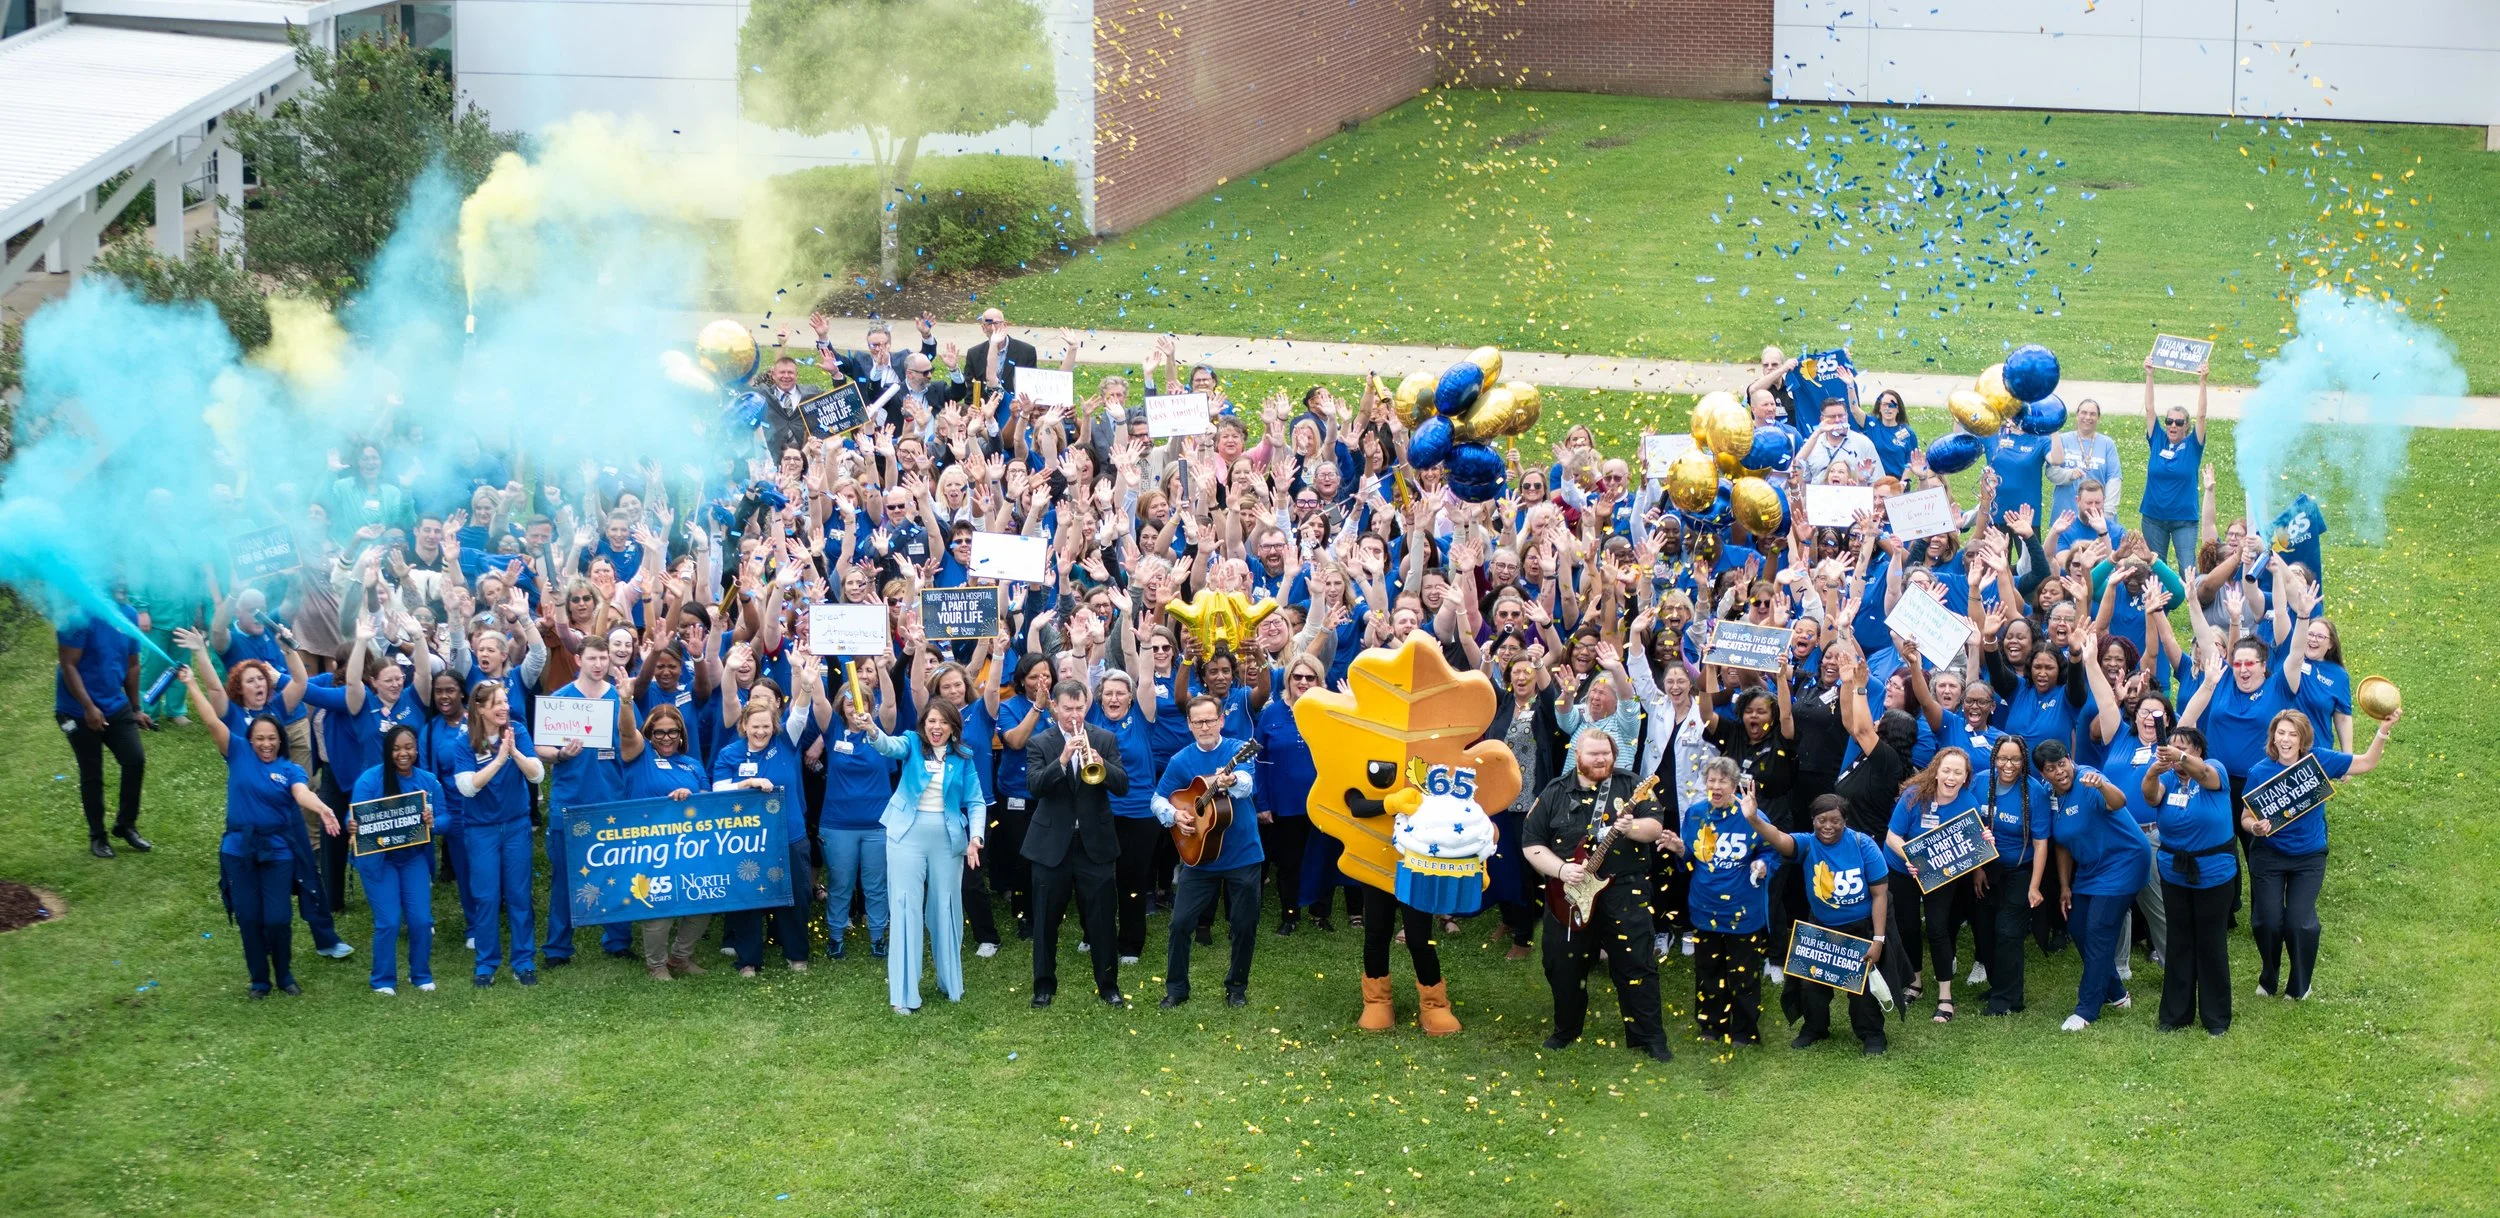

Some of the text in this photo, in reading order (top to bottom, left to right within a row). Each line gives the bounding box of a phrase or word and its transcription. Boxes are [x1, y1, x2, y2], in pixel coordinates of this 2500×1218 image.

[2156, 348, 2170, 357] FOR
[2161, 340, 2206, 355] THANK YOU
[1817, 354, 1838, 373] 65
[816, 398, 830, 408] THAN
[833, 388, 854, 401] HOSPITAL
[818, 398, 846, 417] A PART OF
[817, 412, 838, 426] YOUR
[837, 405, 852, 420] LIFE
[2288, 512, 2310, 538] 65
[2290, 533, 2312, 546] Years
[944, 592, 960, 601] THAN
[966, 591, 993, 600] HOSPITAL
[941, 600, 979, 612] A PART OF
[937, 611, 983, 624] YOUR LIFE
[1716, 639, 1780, 656] GREATEST LEGACY
[1722, 631, 1737, 640] YOUR
[1767, 637, 1780, 646] OUR
[572, 702, 594, 712] are
[1428, 768, 1475, 799] 65
[2254, 764, 2314, 808] THANK YOU
[2261, 802, 2280, 818] FOR
[2278, 794, 2291, 808] 65
[2288, 776, 2320, 800] YEARS!
[360, 813, 376, 823] YOUR
[376, 809, 398, 820] HEALTH
[405, 805, 417, 814] OUR
[359, 814, 421, 835] GREATEST LEGACY
[596, 815, 761, 841] CELEBRATING 65 YEARS
[1908, 843, 1927, 854] MORE
[1925, 834, 1942, 845] THAN
[1946, 817, 1974, 834] HOSPITAL
[1927, 830, 1964, 857] A PART OF
[587, 828, 768, 868] Caring for You!
[1715, 832, 1747, 860] 65
[1928, 839, 1975, 870] YOUR LIFE
[650, 876, 672, 894] 65
[680, 873, 730, 890] NORTH
[1834, 868, 1864, 896] 65
[650, 894, 672, 902] Years
[686, 885, 727, 901] OAKS
[1833, 893, 1864, 905] Years
[1800, 936, 1860, 959] YOUR HEALTH IS OUR
[1795, 945, 1862, 972] GREATEST LEGACY
